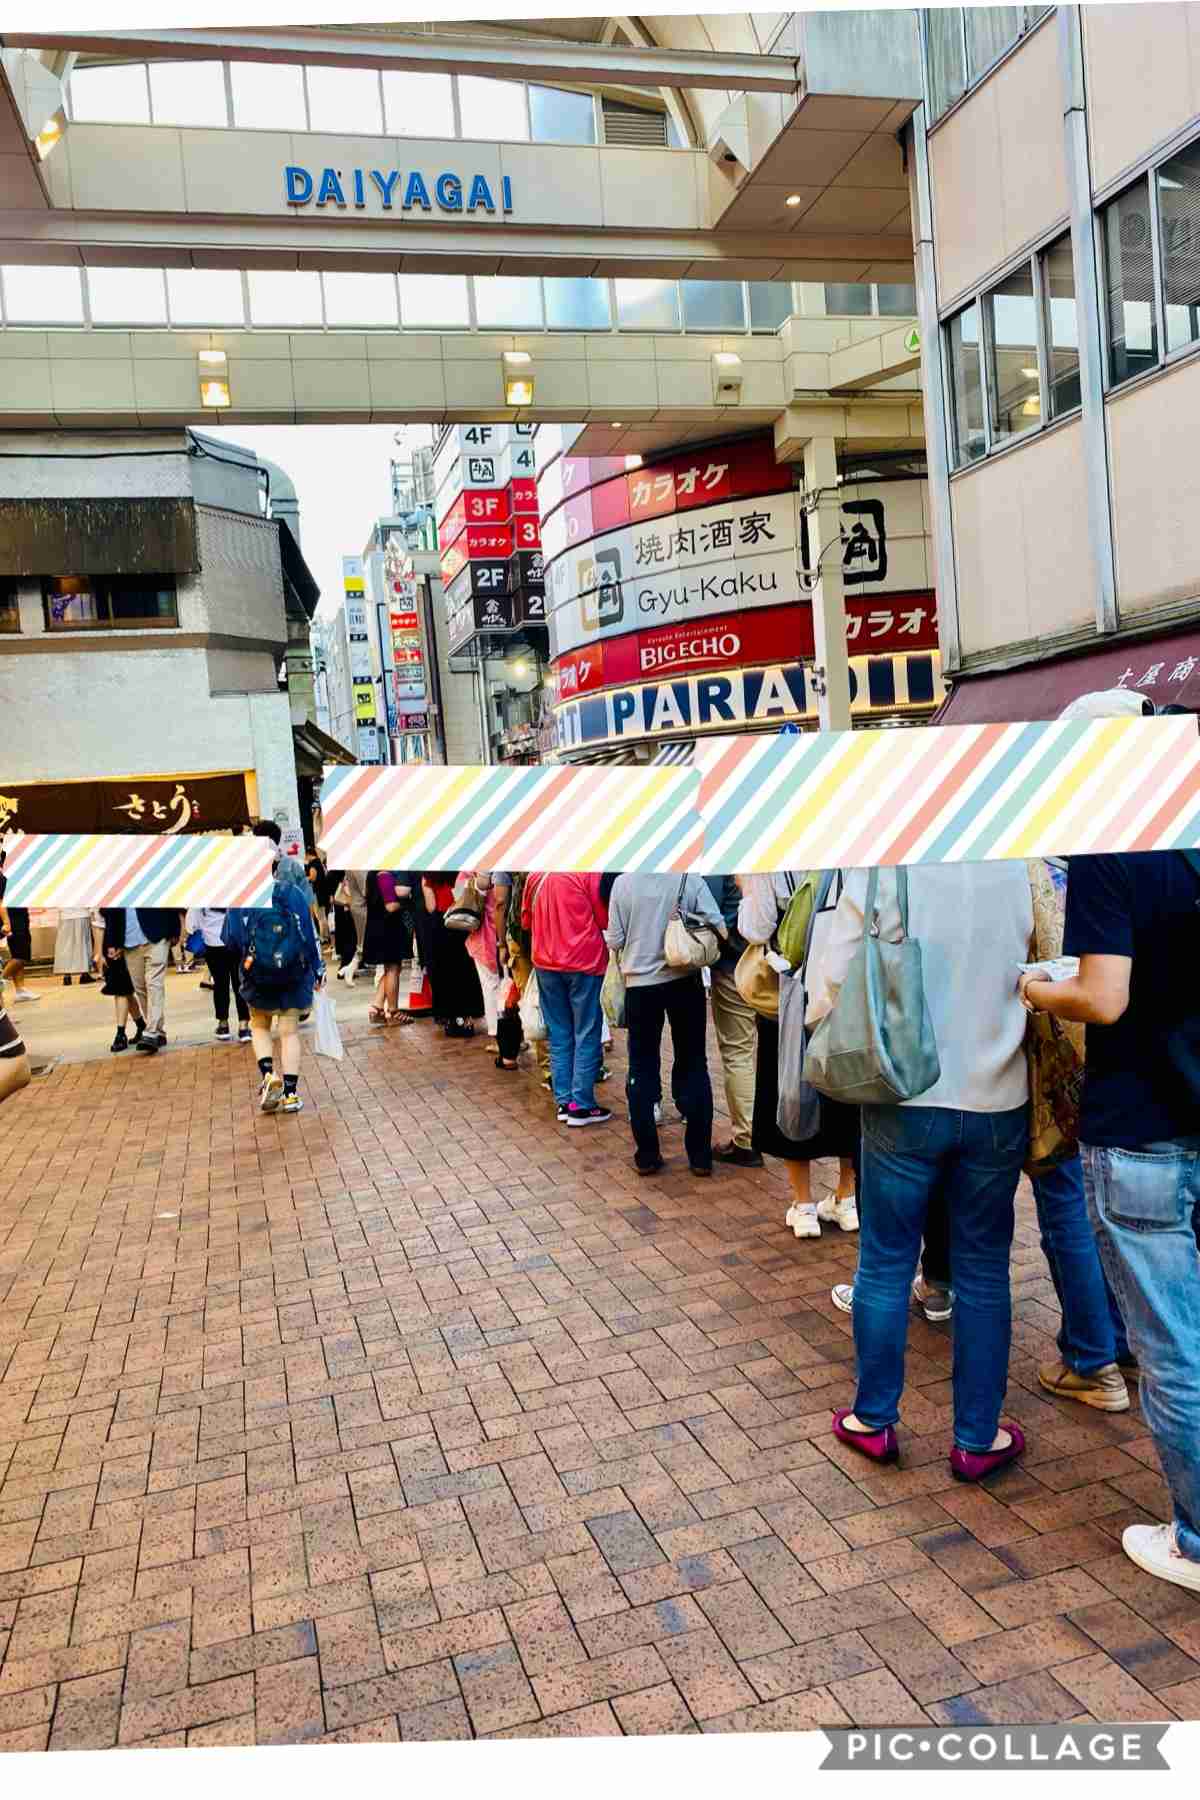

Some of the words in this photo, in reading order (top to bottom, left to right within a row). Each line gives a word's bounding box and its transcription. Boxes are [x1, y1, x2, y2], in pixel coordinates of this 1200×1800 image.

[284, 166, 513, 213] DAIYAGAI
[465, 427, 492, 444] 4F
[516, 449, 536, 468] 4
[632, 463, 729, 507] カラオケ
[471, 498, 499, 516] 3F
[469, 537, 507, 548] カラオケ
[634, 510, 776, 565] 焼肉酒家
[476, 568, 505, 588] 2F
[638, 571, 778, 615] Gyu-Kaku
[1114, 656, 1200, 688] 土屋商
[112, 784, 191, 834] さとう
